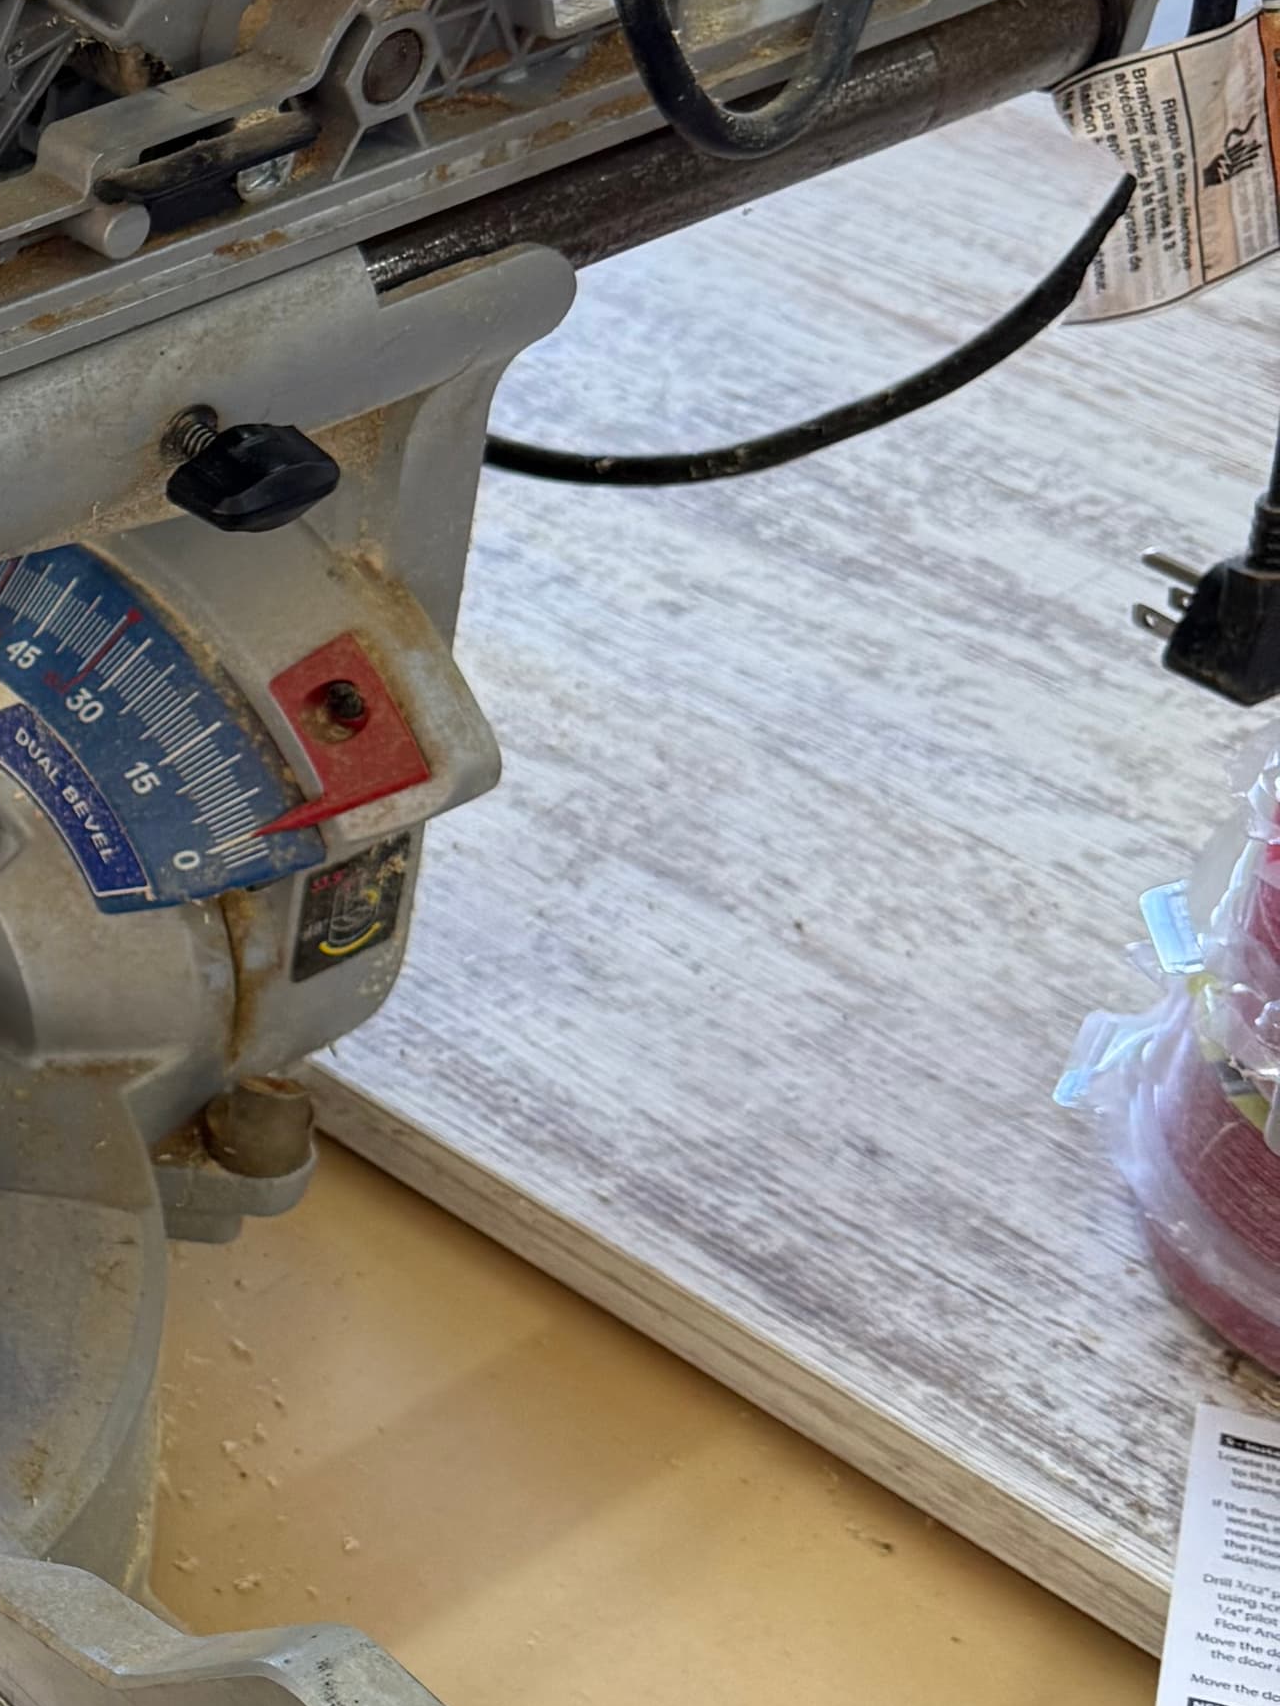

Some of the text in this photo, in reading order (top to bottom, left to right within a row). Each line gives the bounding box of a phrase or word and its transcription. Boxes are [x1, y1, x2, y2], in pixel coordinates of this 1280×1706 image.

[5, 640, 42, 670] 45
[65, 687, 104, 724] 30
[124, 761, 162, 795] 15
[172, 850, 201, 871] 0
[14, 726, 120, 864] DUAL BEVEL
